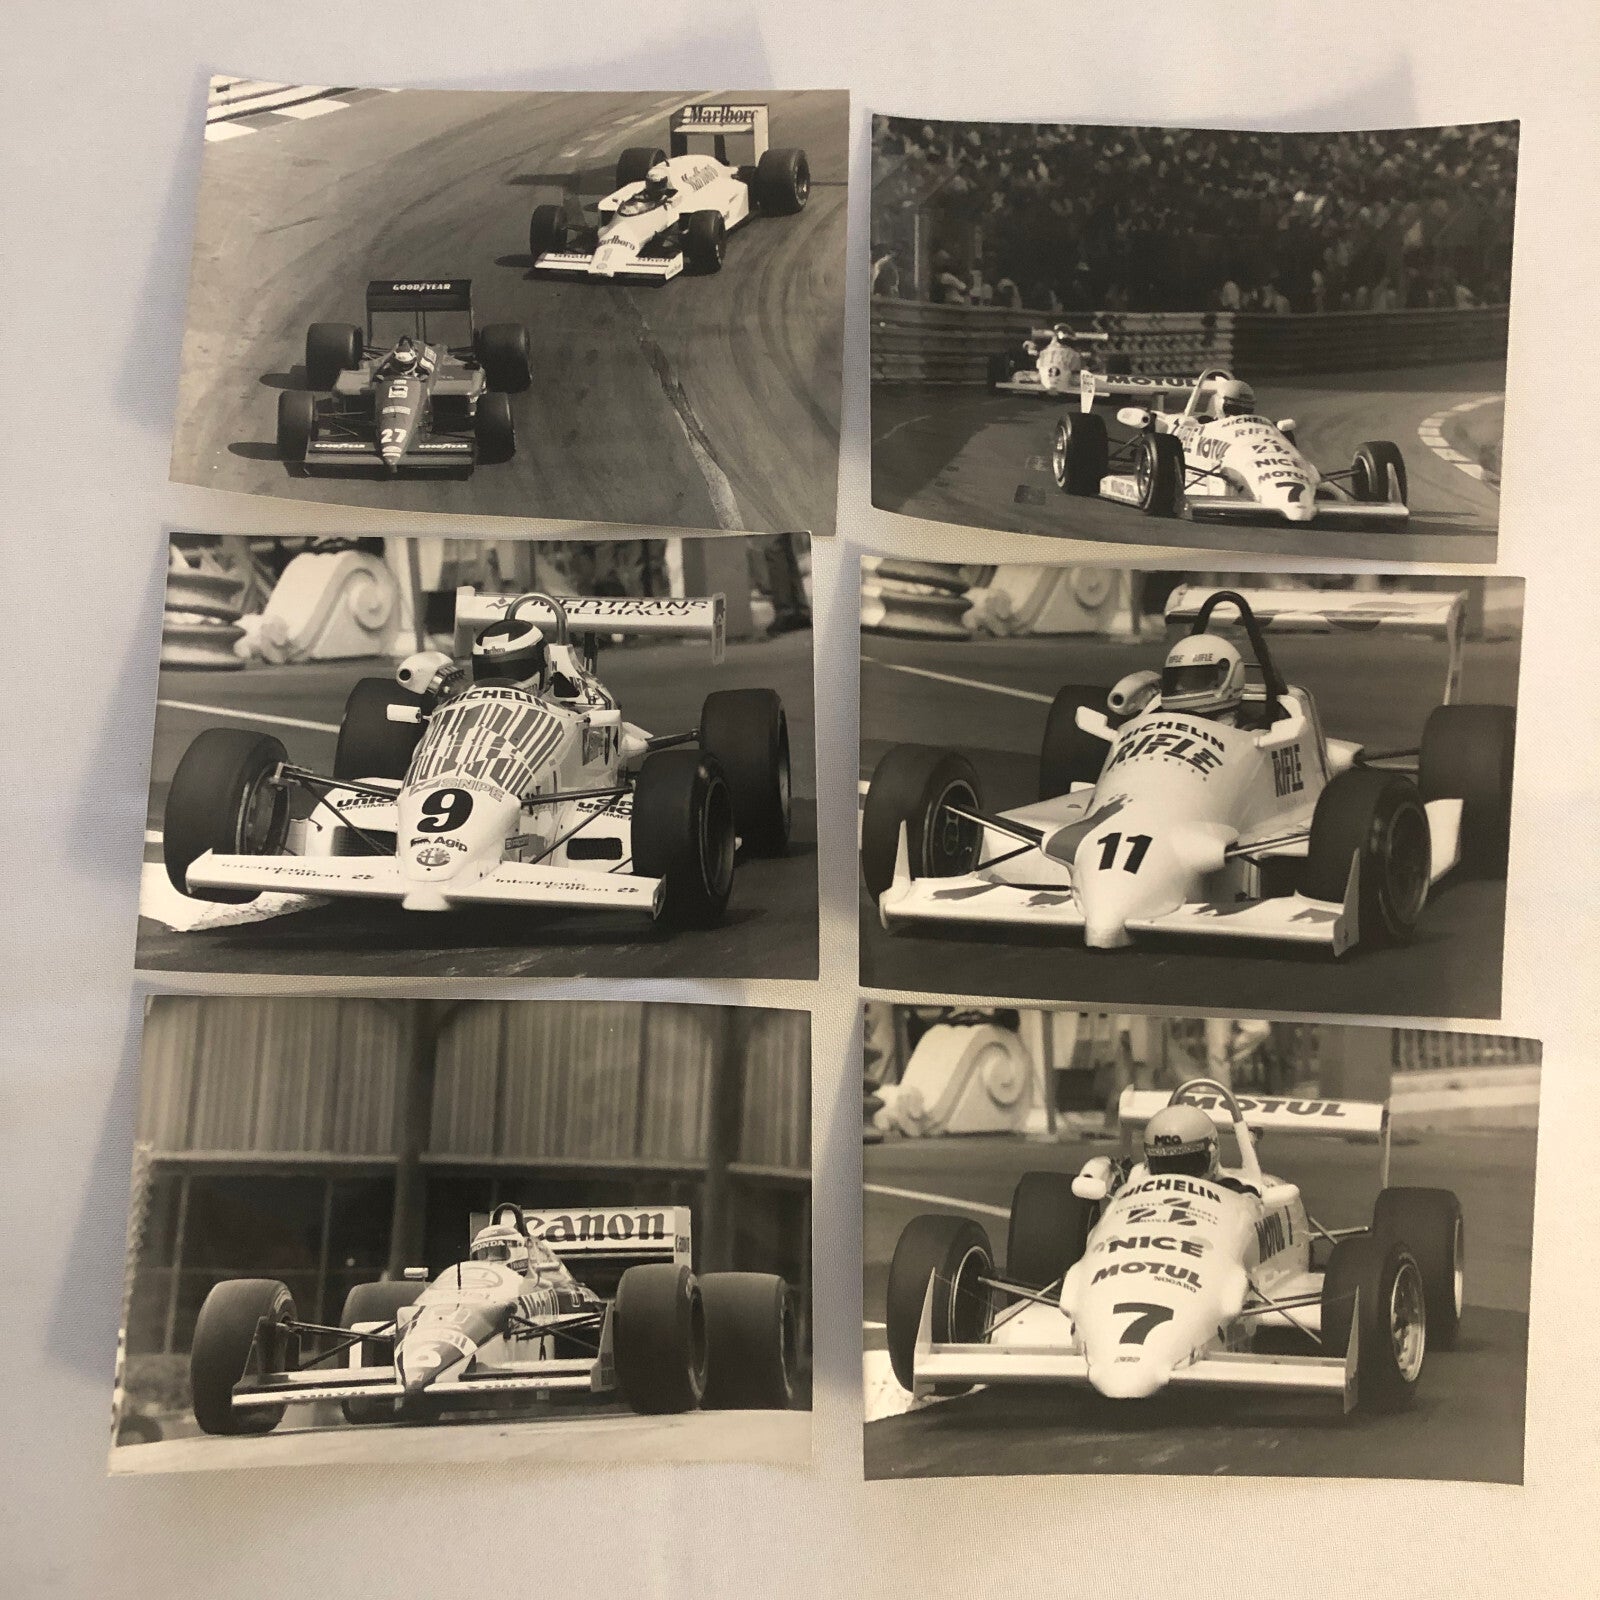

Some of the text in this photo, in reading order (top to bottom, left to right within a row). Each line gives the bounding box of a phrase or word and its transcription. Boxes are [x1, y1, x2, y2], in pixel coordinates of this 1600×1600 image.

[600, 235, 635, 250] arlboro
[392, 283, 451, 292] GOODYEAR
[380, 428, 407, 443] 27
[1275, 482, 1305, 503] 7
[443, 690, 549, 711] MICHELIN
[1119, 721, 1225, 752] MICHELIN
[1106, 733, 1223, 775] RIFLE
[416, 788, 474, 834] 9
[434, 836, 468, 852] Agip
[1097, 832, 1153, 875] 11
[1178, 1096, 1346, 1116] MOTUL
[1119, 1179, 1222, 1203] MICHELIN
[1108, 1236, 1204, 1258] NICE
[1091, 1262, 1202, 1289] MOTUL
[1112, 1302, 1175, 1346] 7
